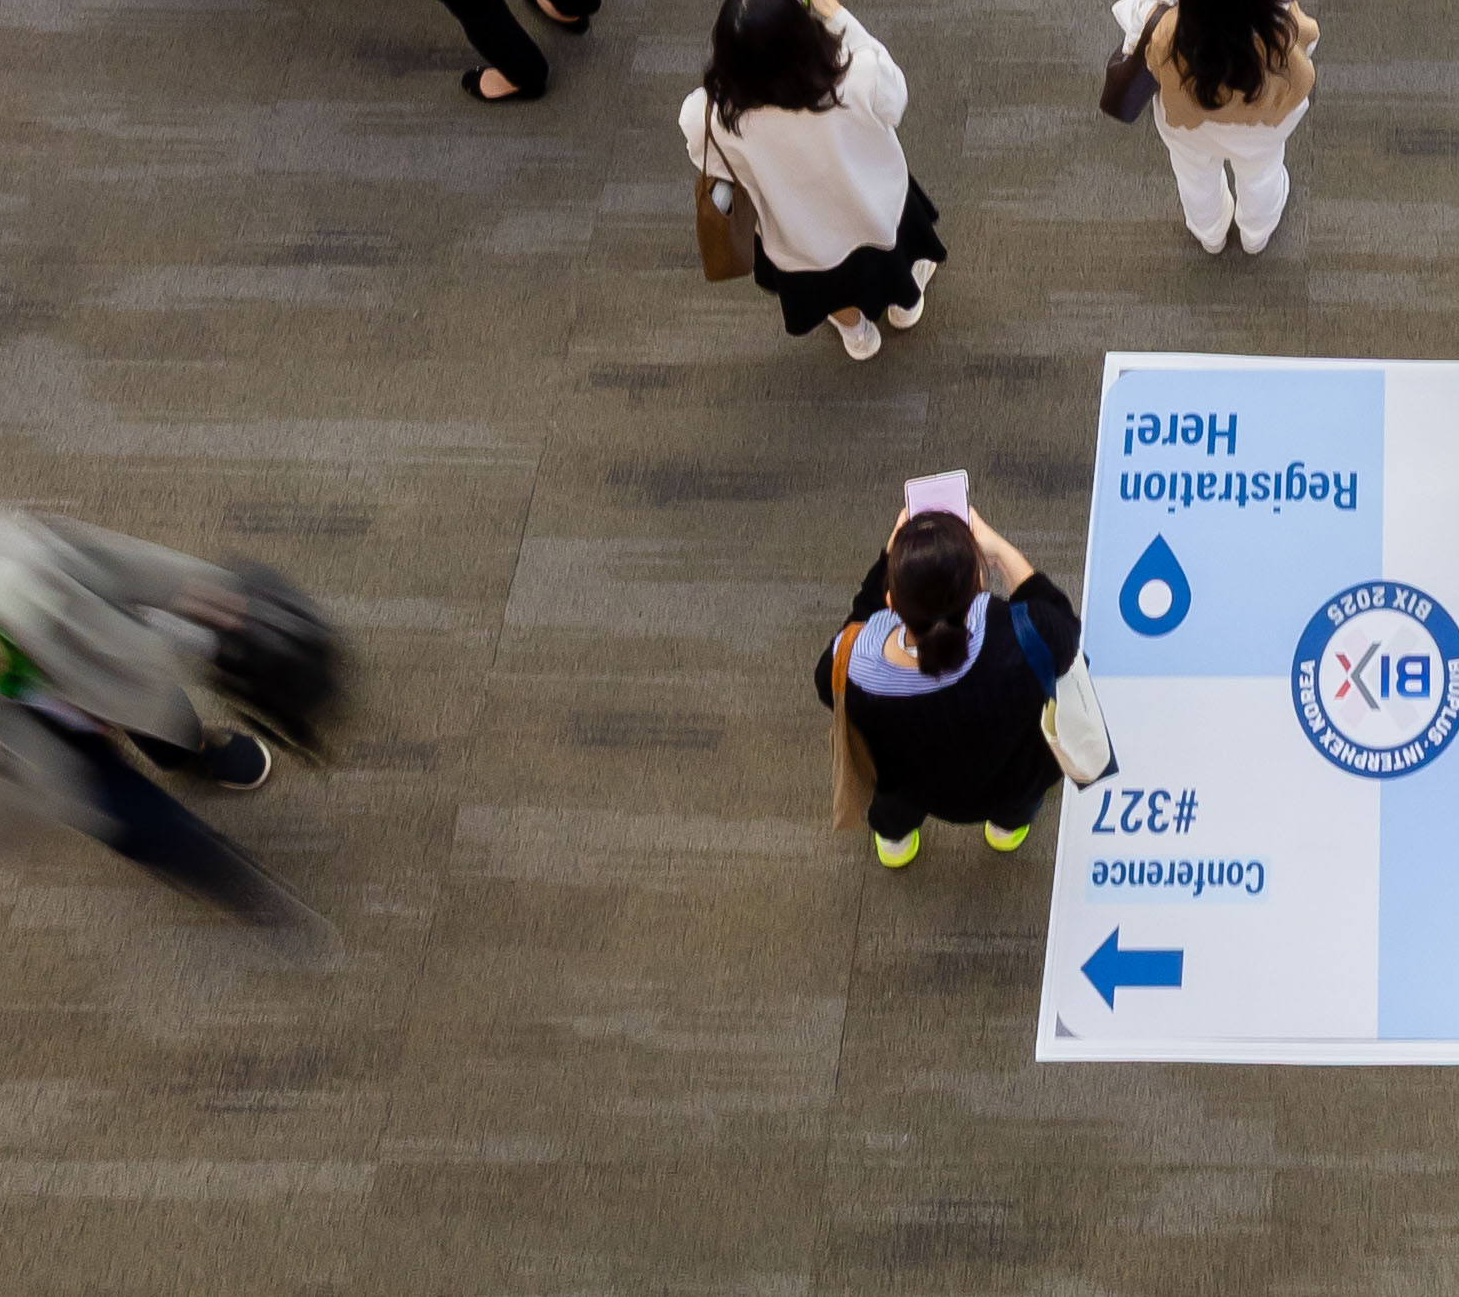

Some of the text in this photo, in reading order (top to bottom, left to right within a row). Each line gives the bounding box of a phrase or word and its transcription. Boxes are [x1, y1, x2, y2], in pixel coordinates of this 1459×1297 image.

[1123, 412, 1238, 457] Here!
[1119, 460, 1359, 514] Registration
[1327, 585, 1432, 626] BIX 2025
[1299, 660, 1326, 733] KOREA
[1334, 640, 1430, 711] BIX
[1091, 788, 1199, 835] #327
[1090, 858, 1267, 898] Conference
